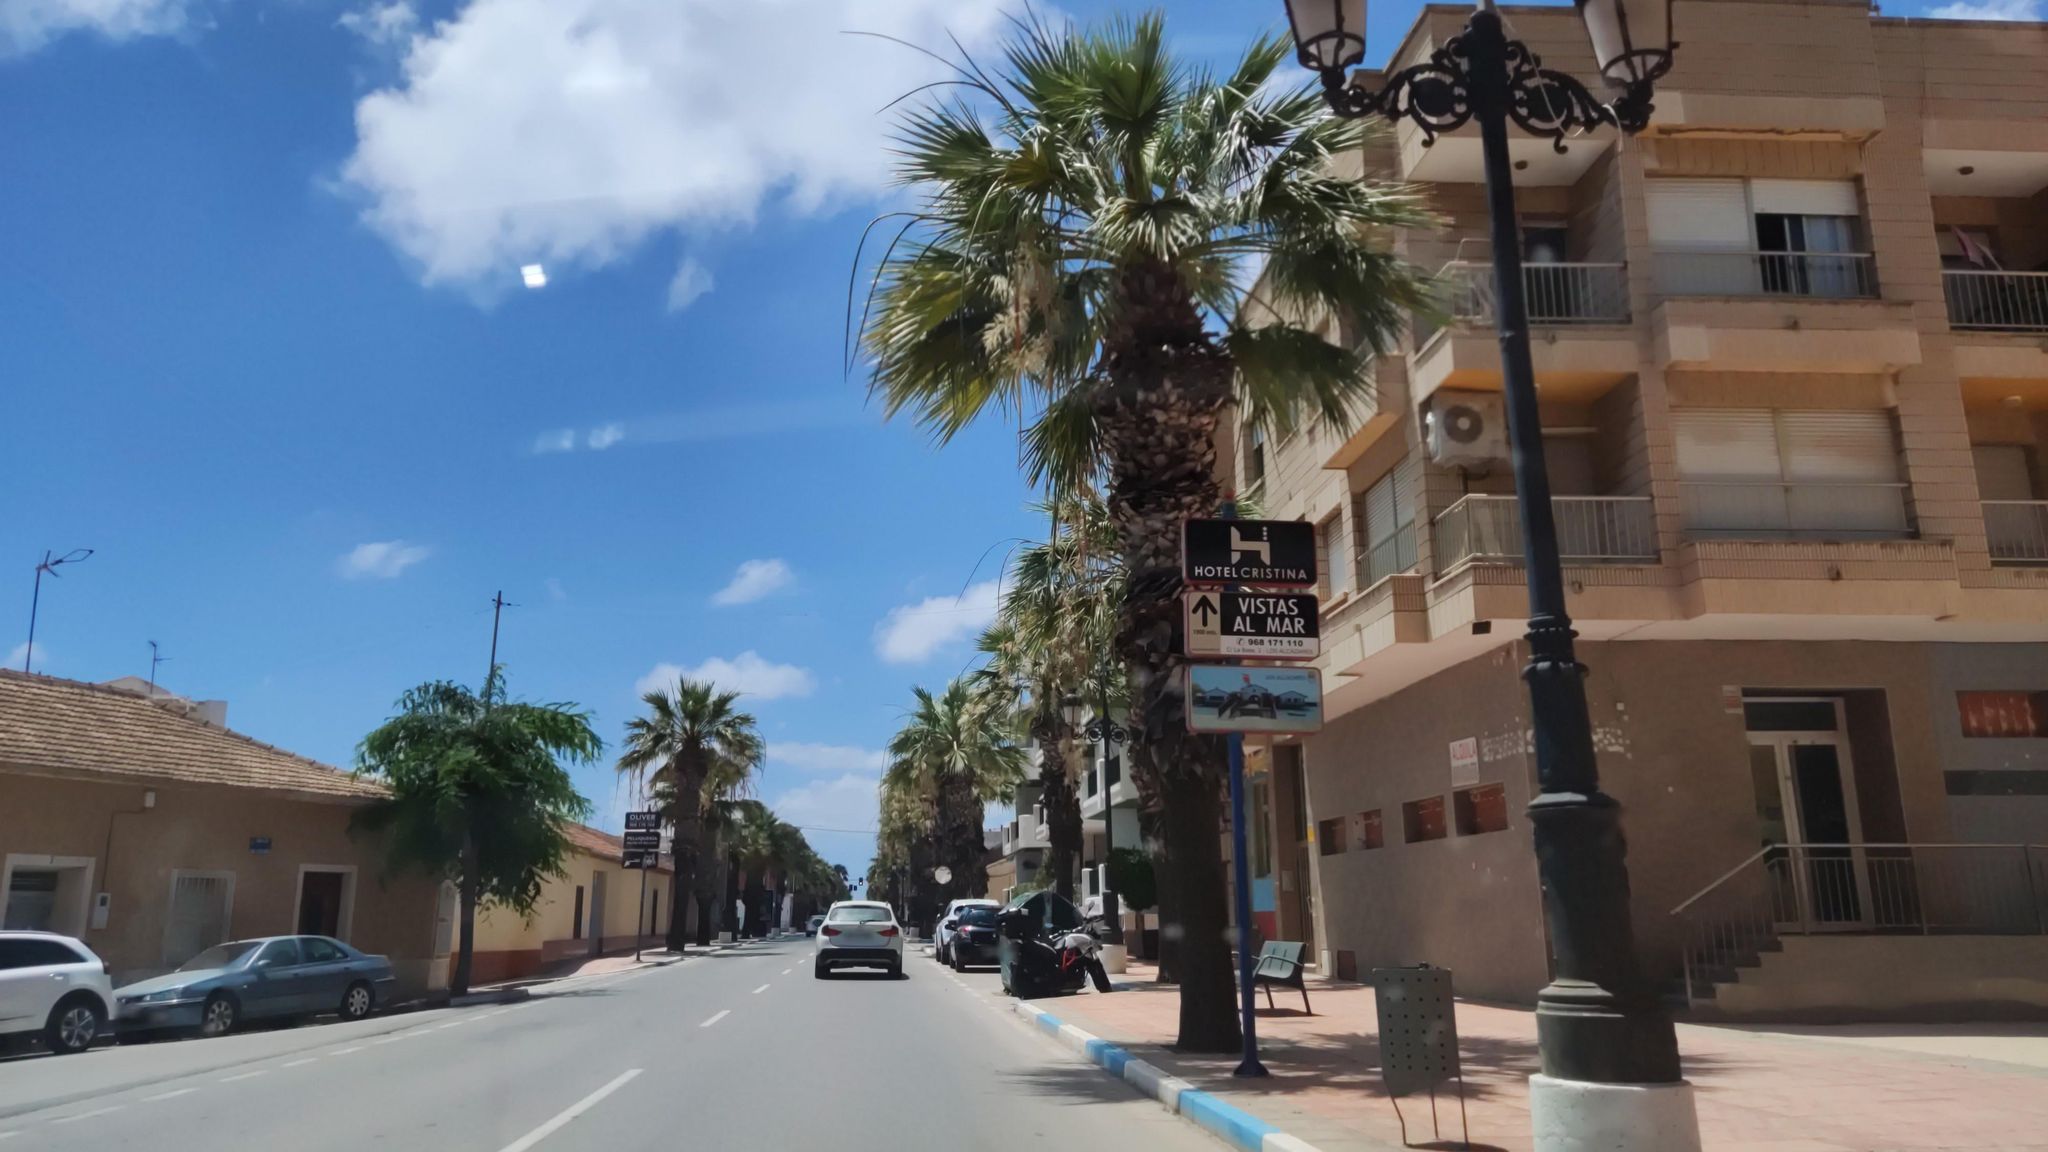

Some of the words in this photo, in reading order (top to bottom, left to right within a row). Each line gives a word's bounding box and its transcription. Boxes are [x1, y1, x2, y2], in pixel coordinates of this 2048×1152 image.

[1194, 566, 1238, 578] HOTEL
[1240, 567, 1308, 580] CRISTINA
[1238, 597, 1299, 615] VISTAS
[1233, 616, 1256, 633] AL
[1266, 617, 1306, 634] MAR
[1248, 638, 1264, 646] 968
[1268, 639, 1283, 647] 171
[1287, 640, 1304, 648] 110
